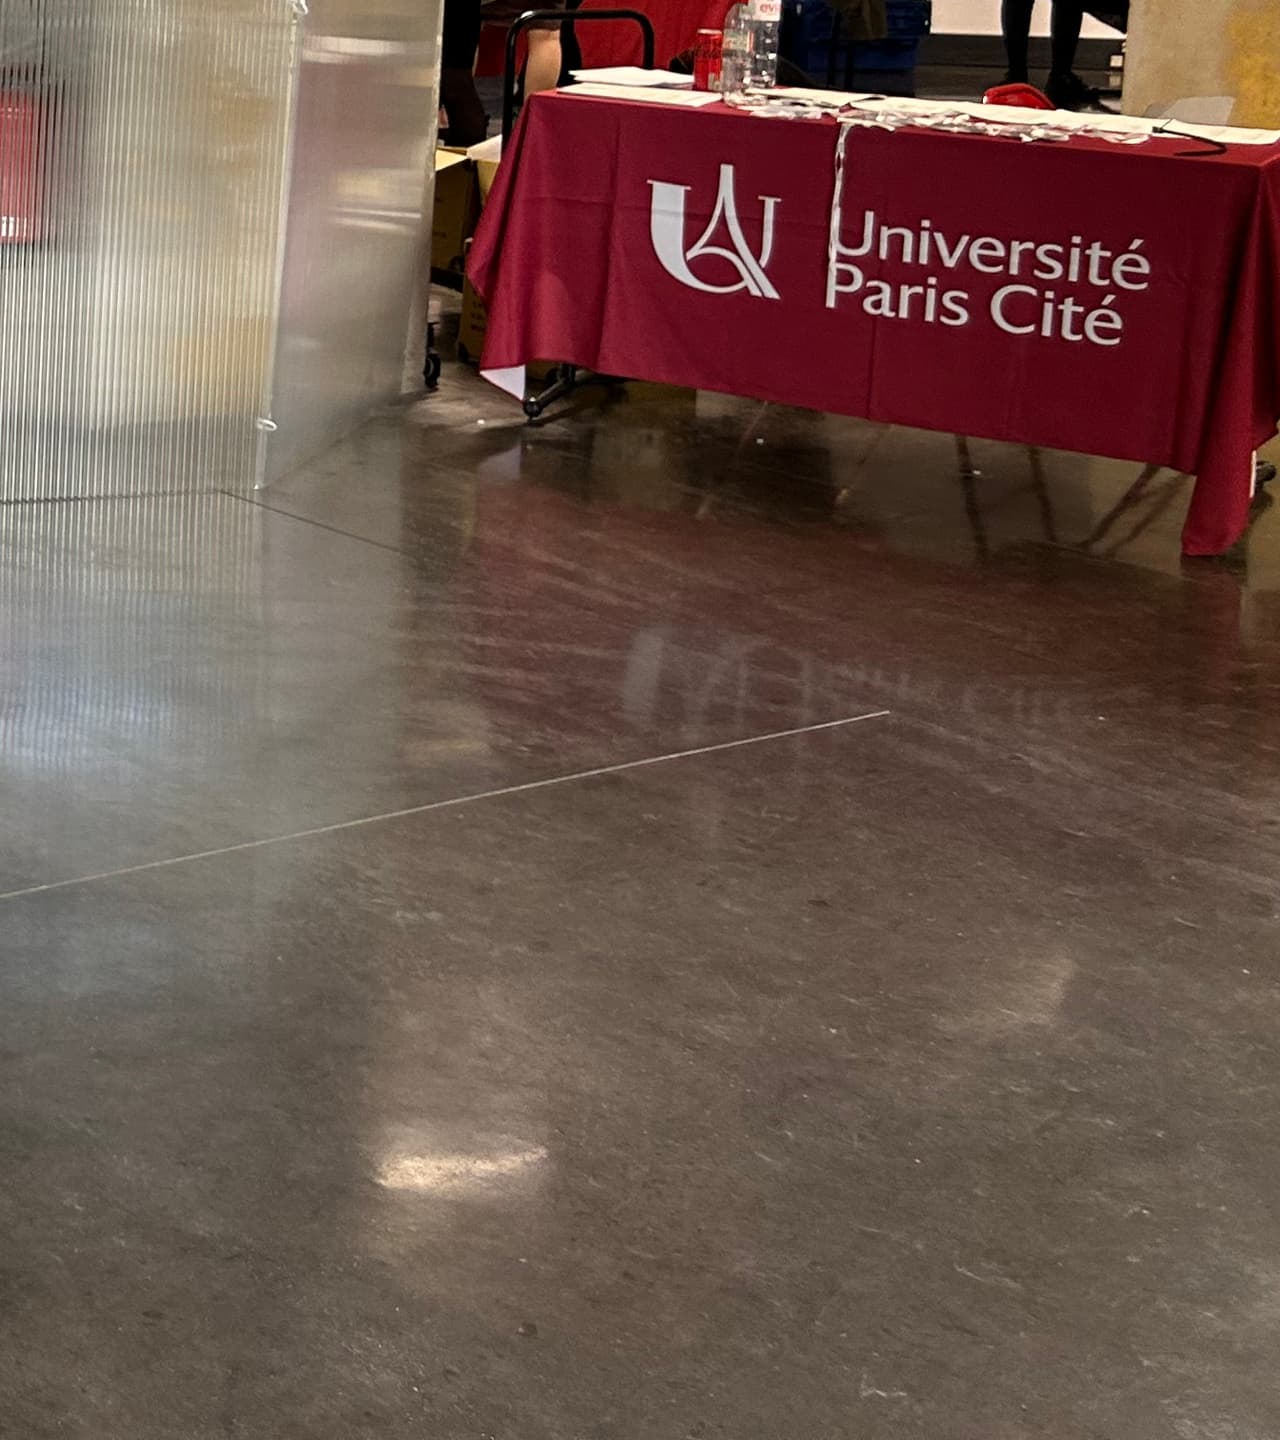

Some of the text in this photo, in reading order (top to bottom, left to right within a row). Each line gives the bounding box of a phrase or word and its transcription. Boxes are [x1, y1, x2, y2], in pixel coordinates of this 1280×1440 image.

[831, 208, 1152, 292] Université
[826, 261, 1125, 347] Paris Cité
